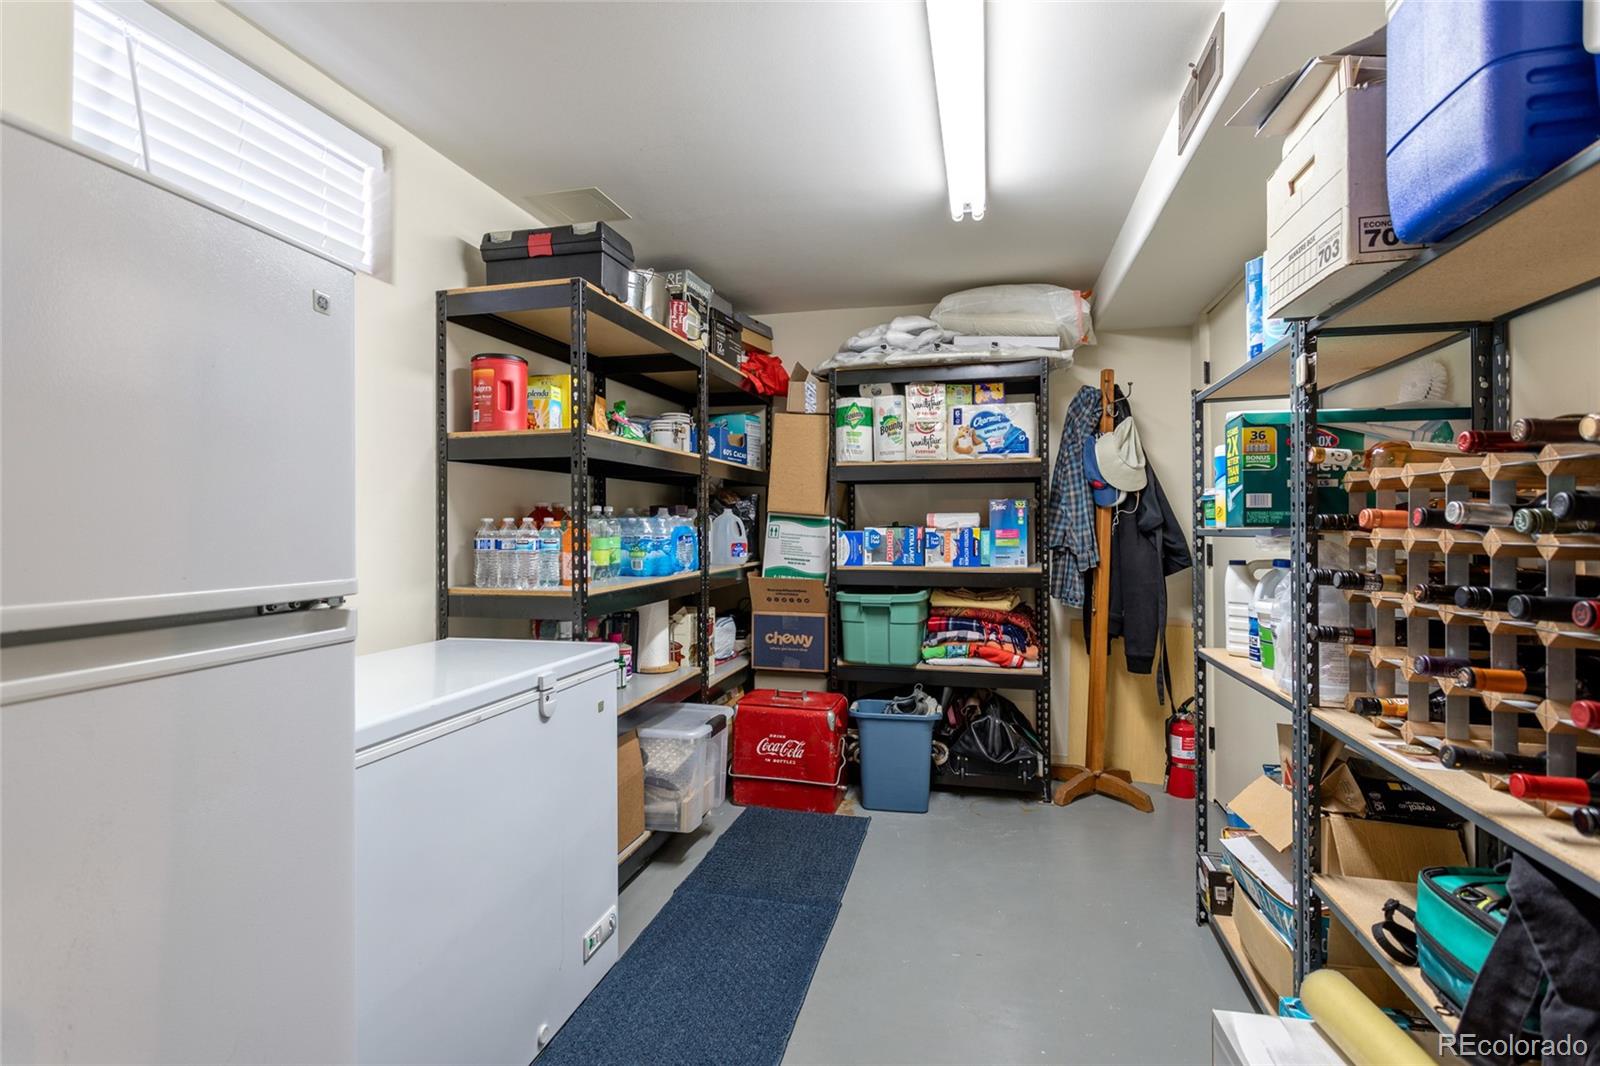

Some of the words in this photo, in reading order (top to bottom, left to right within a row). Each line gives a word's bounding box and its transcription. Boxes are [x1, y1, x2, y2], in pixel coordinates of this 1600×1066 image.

[1363, 219, 1393, 229] ECONO
[1364, 228, 1400, 247] 70
[1318, 238, 1340, 268] 703
[527, 389, 549, 398] plenda
[880, 421, 903, 435] Bounty
[1251, 431, 1266, 440] 36
[1227, 434, 1239, 457] 2X
[1246, 454, 1271, 462] BONUS
[765, 631, 814, 649] chewy
[756, 738, 806, 759] Coca-Cola
